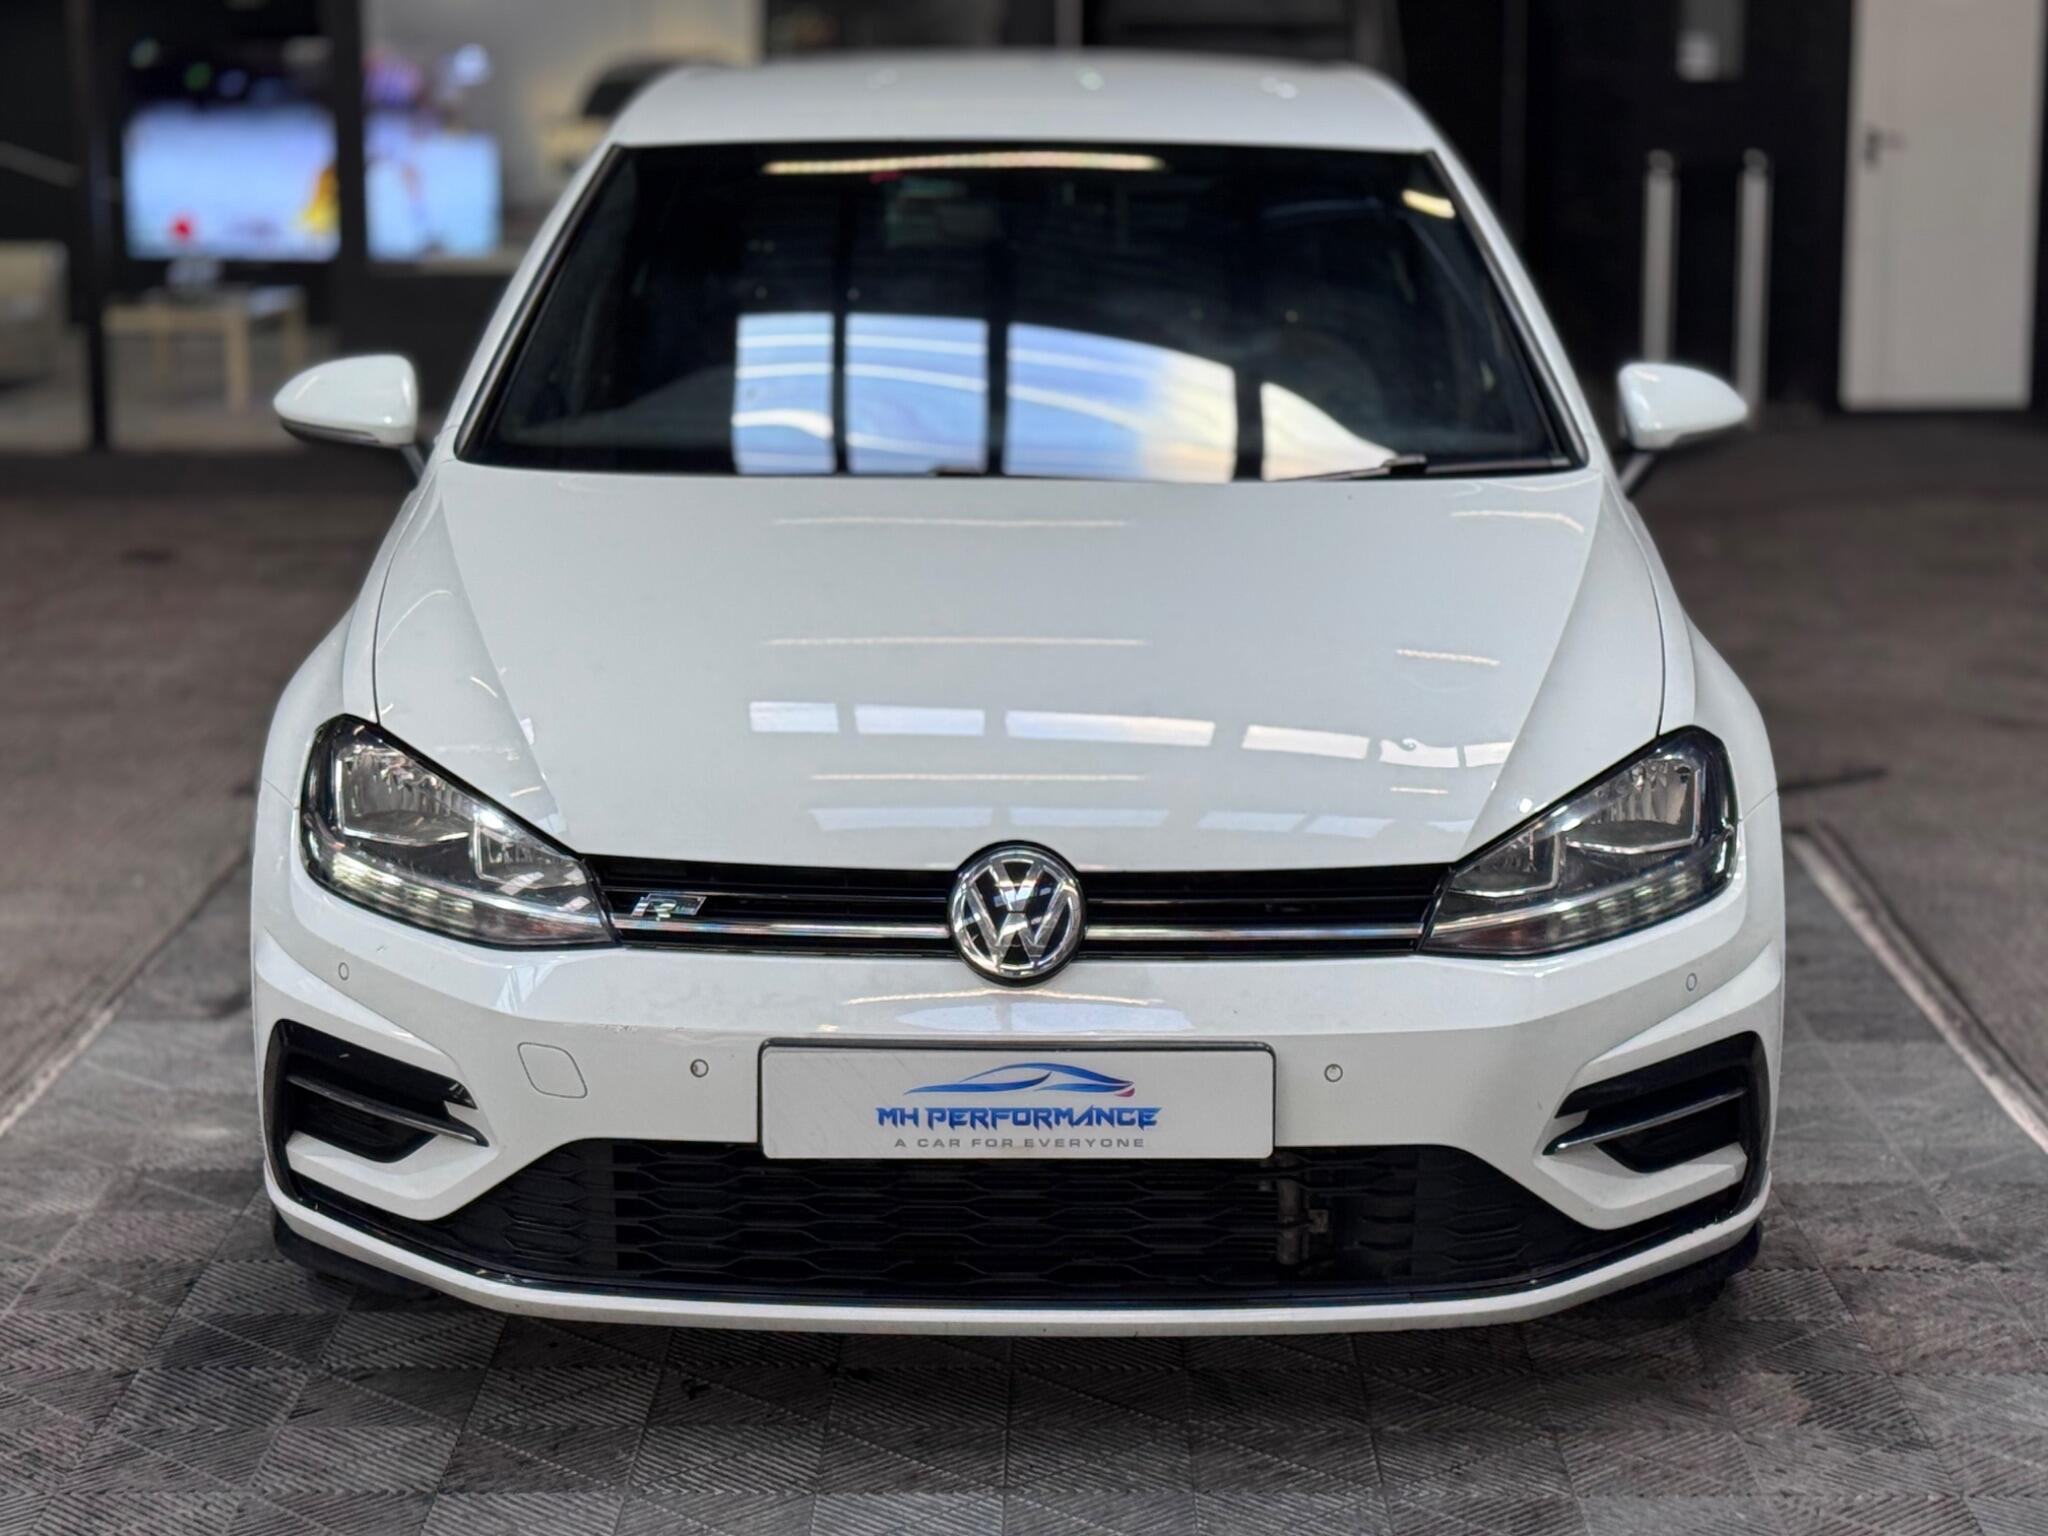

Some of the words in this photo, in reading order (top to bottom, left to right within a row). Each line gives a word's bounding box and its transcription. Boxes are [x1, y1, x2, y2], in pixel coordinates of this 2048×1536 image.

[960, 855, 1079, 969] VW
[875, 1107, 920, 1128] MH
[925, 1104, 1162, 1131] PERFORMANCE
[894, 1138, 907, 1148] A
[917, 1138, 961, 1148] CAR
[971, 1138, 1014, 1148] FOR
[1024, 1138, 1144, 1148] EVERYONE
